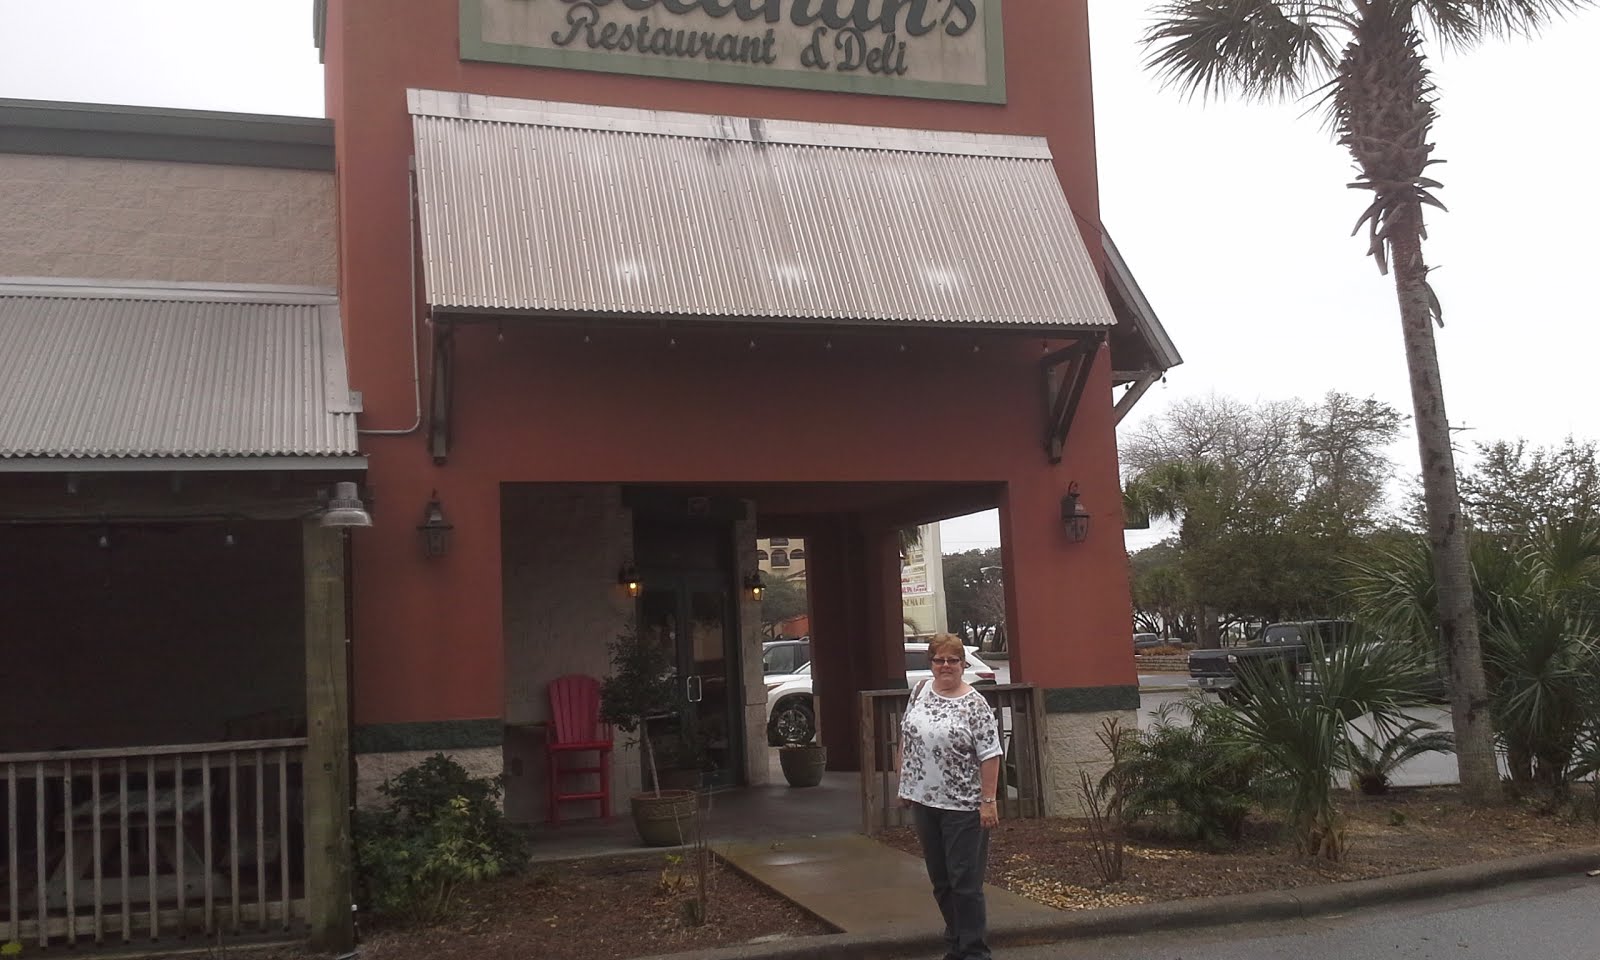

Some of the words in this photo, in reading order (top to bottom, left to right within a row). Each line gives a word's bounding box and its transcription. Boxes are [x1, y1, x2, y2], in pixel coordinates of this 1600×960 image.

[551, 2, 777, 64] Restaurant
[800, 26, 830, 69] &
[834, 26, 908, 75] Deli
